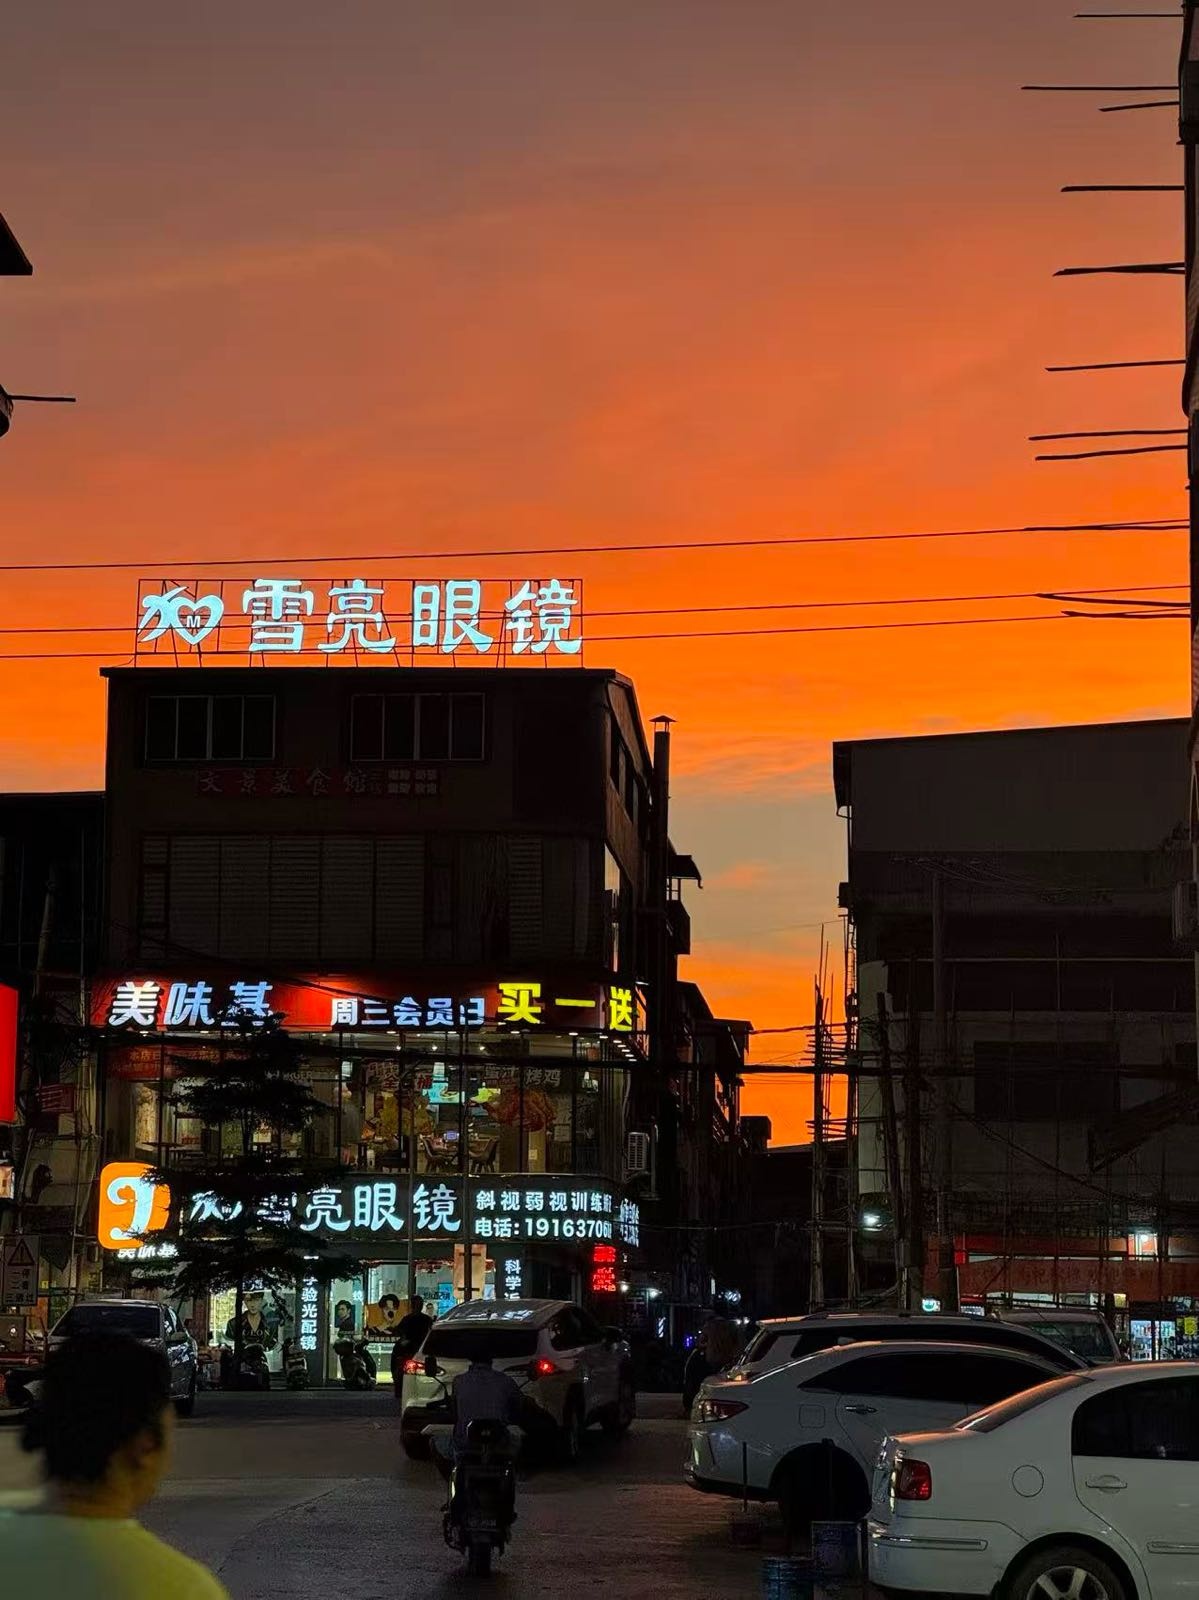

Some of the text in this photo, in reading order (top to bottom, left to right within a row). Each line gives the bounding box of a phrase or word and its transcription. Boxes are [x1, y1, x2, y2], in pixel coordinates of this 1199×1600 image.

[242, 579, 582, 653] 雪亮眼镜
[109, 981, 632, 1032] 美味基 周三会员日 买一送
